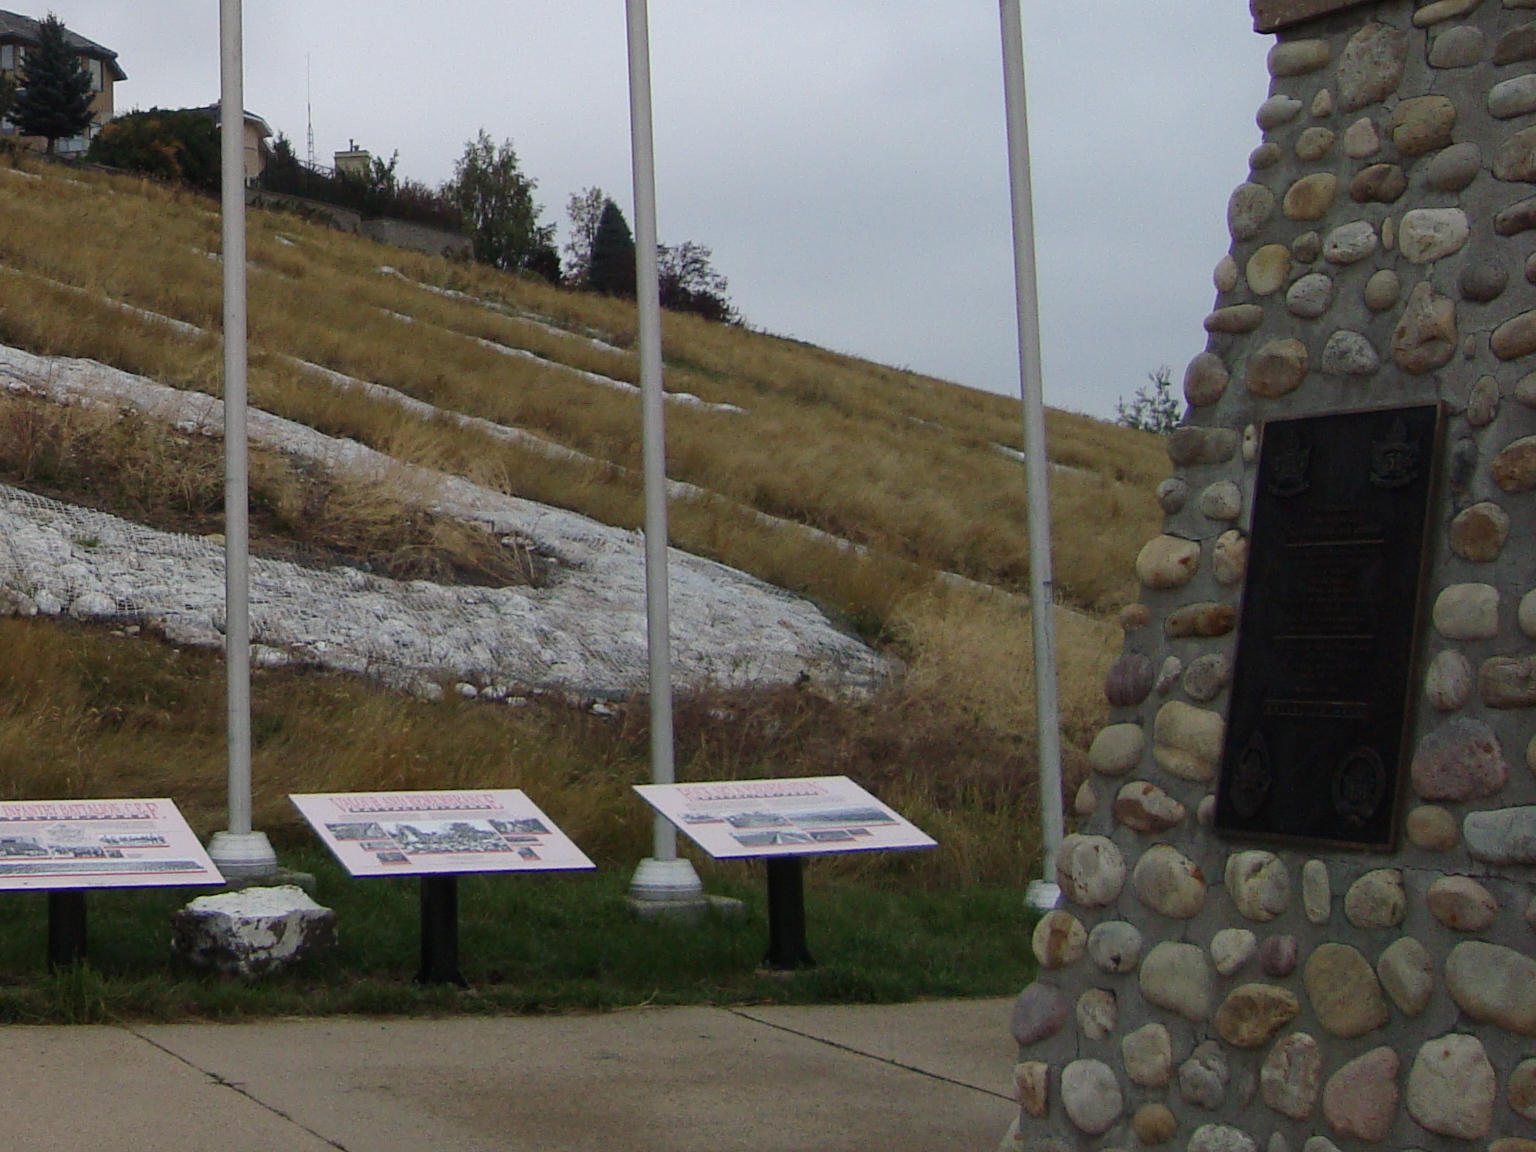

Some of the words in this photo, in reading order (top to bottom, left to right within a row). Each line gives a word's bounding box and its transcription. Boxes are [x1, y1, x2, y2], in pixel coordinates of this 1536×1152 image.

[2, 804, 59, 817] INFANTRY
[329, 796, 381, 812] VALOUR
[383, 796, 406, 807] AND
[406, 794, 504, 809] REMEMBRANCE
